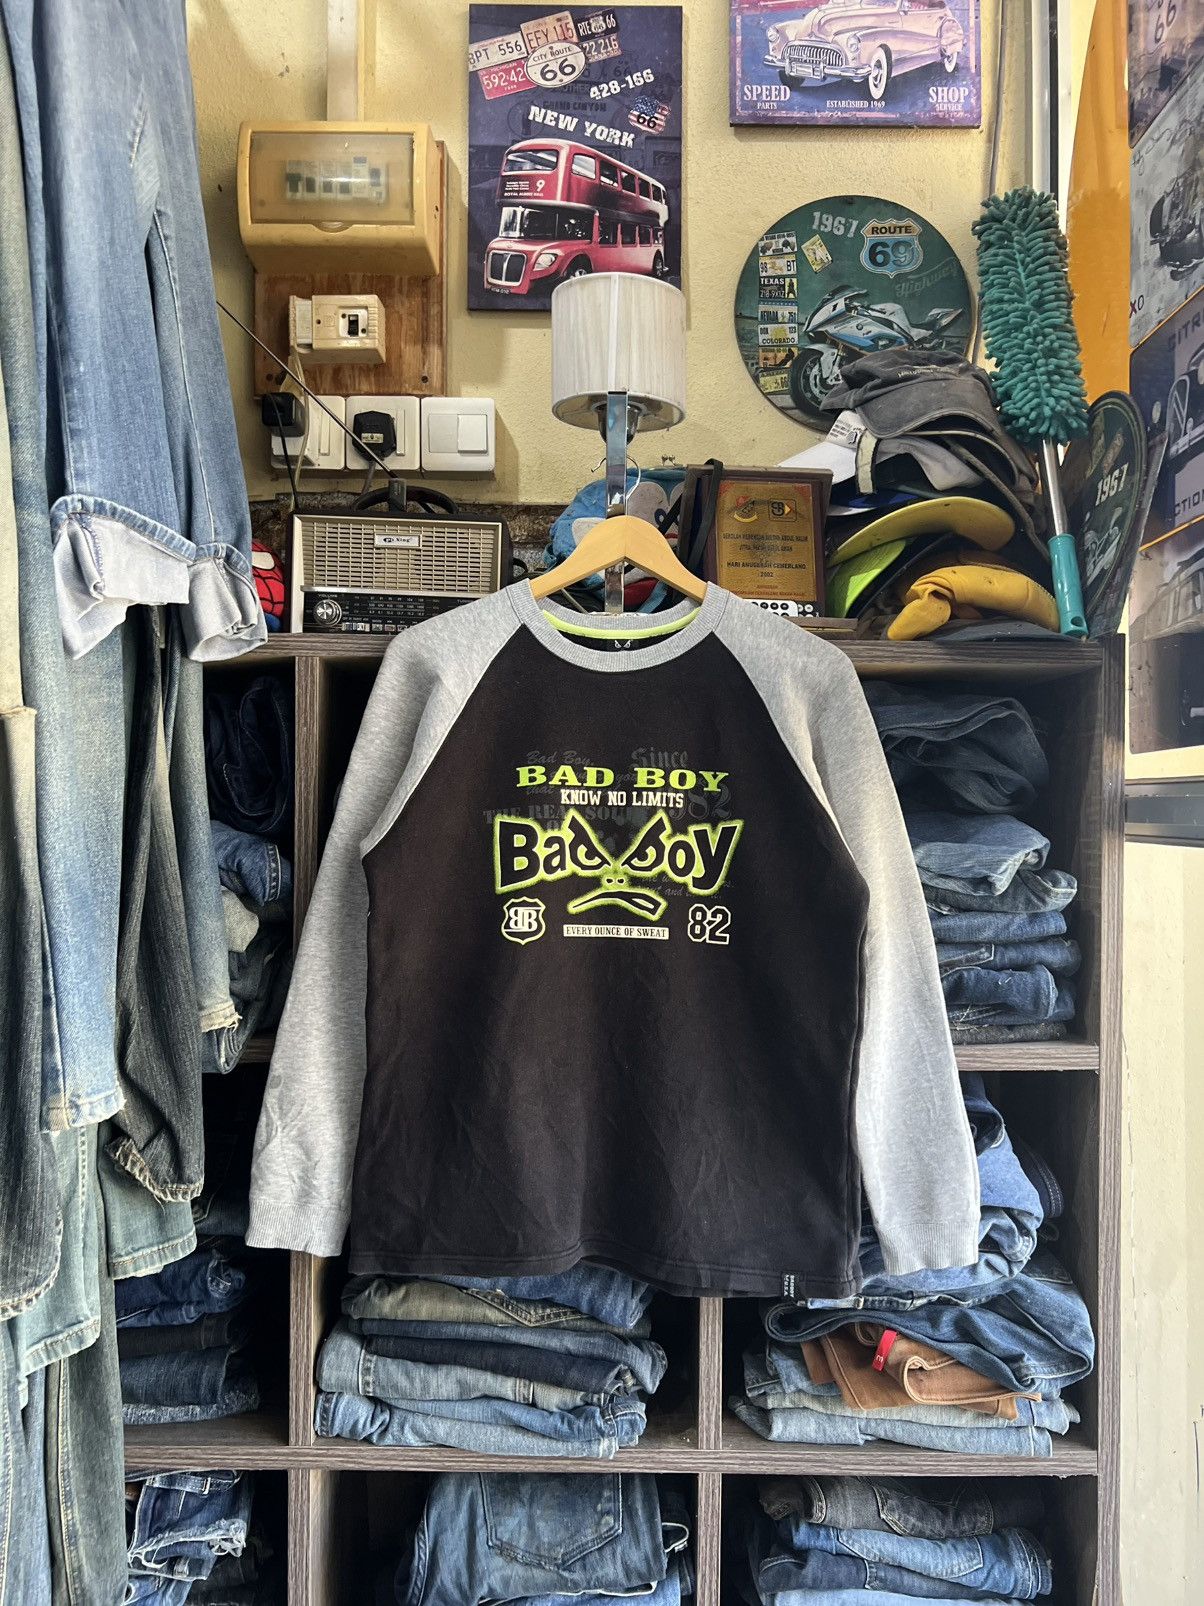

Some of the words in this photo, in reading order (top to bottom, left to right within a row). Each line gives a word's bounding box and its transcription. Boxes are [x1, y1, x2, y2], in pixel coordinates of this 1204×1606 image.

[578, 20, 591, 36] RTE
[606, 14, 616, 28] 66
[498, 40, 522, 56] 556
[533, 52, 548, 62] CITY
[550, 46, 572, 57] ROUTE
[540, 58, 576, 81] 66
[590, 68, 655, 100] 428-166
[743, 85, 791, 101] SPEED
[929, 86, 969, 103] SHOP
[757, 102, 777, 110] PARTS
[826, 100, 869, 108] ESTABLISHED
[870, 100, 885, 108] 1969
[936, 103, 963, 111] SERVICE
[528, 105, 579, 131] NEW
[584, 121, 636, 148] YORK
[637, 112, 658, 128] 66
[536, 180, 545, 192] 9
[811, 211, 858, 237] 1967
[871, 225, 912, 235] ROUTE
[868, 241, 916, 268] 69
[1168, 307, 1204, 351] CITR
[1095, 462, 1129, 507] 1967
[629, 747, 689, 769] Since
[516, 765, 614, 788] BAD
[633, 768, 729, 792] BOY
[560, 789, 601, 806] KNOW
[607, 791, 626, 806] NO
[632, 791, 684, 808] LIMITS
[528, 805, 567, 819] REA
[566, 925, 593, 936] EVERY
[594, 926, 621, 936] OUNCE
[624, 927, 634, 937] OF
[637, 928, 667, 938] SWEAT
[687, 903, 732, 945] 82
